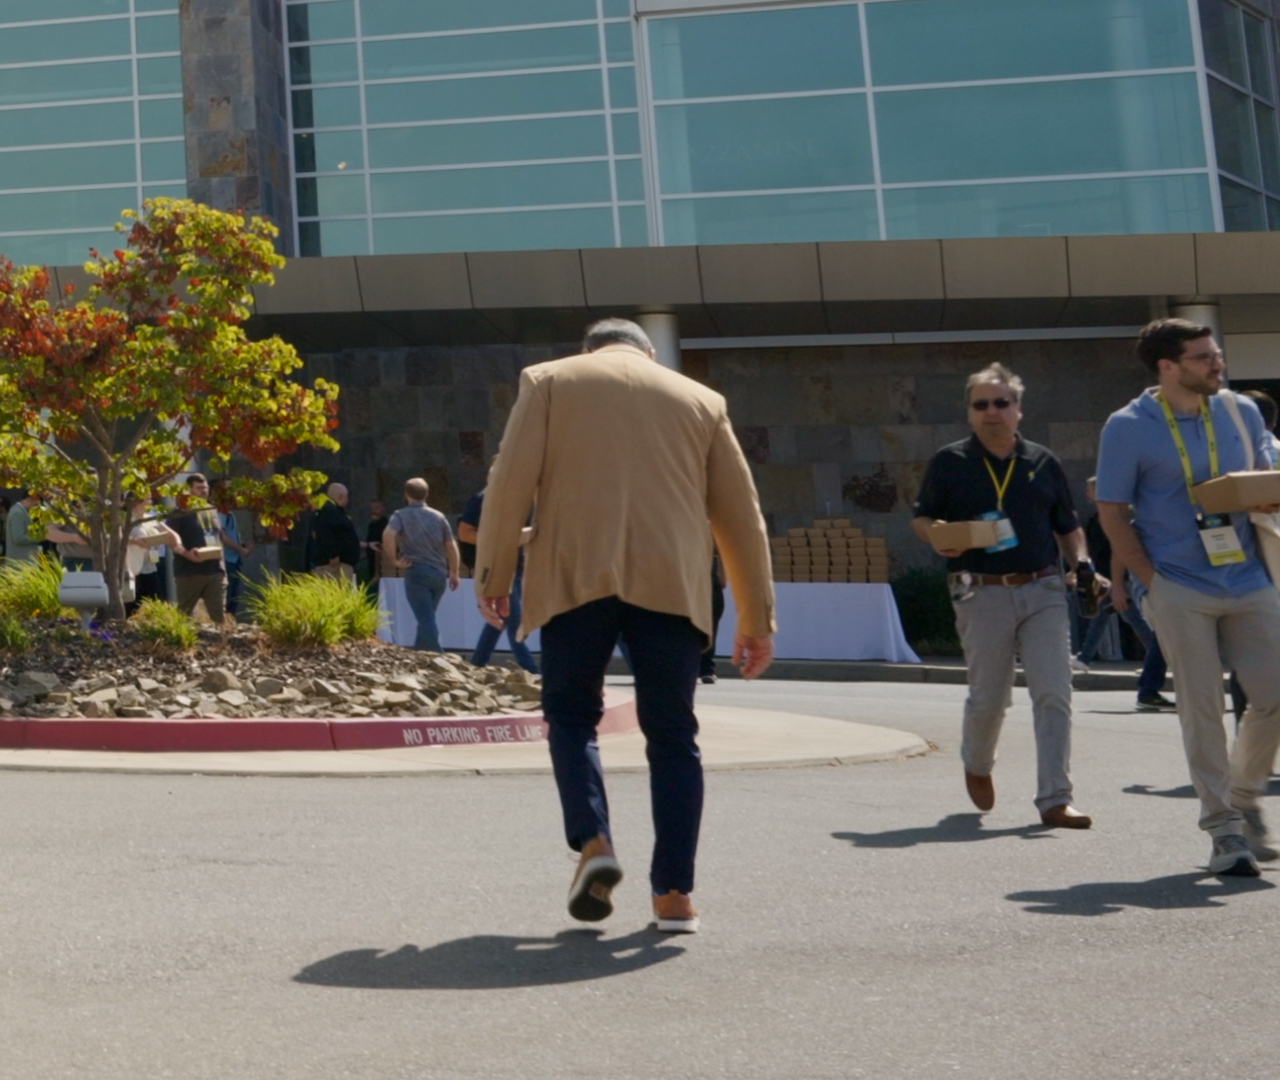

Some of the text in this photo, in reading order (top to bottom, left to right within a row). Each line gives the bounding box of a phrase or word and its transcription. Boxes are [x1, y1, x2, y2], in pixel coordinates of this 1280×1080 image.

[403, 729, 423, 745] NO
[427, 727, 480, 743] PARKING
[486, 726, 514, 742] FIRE
